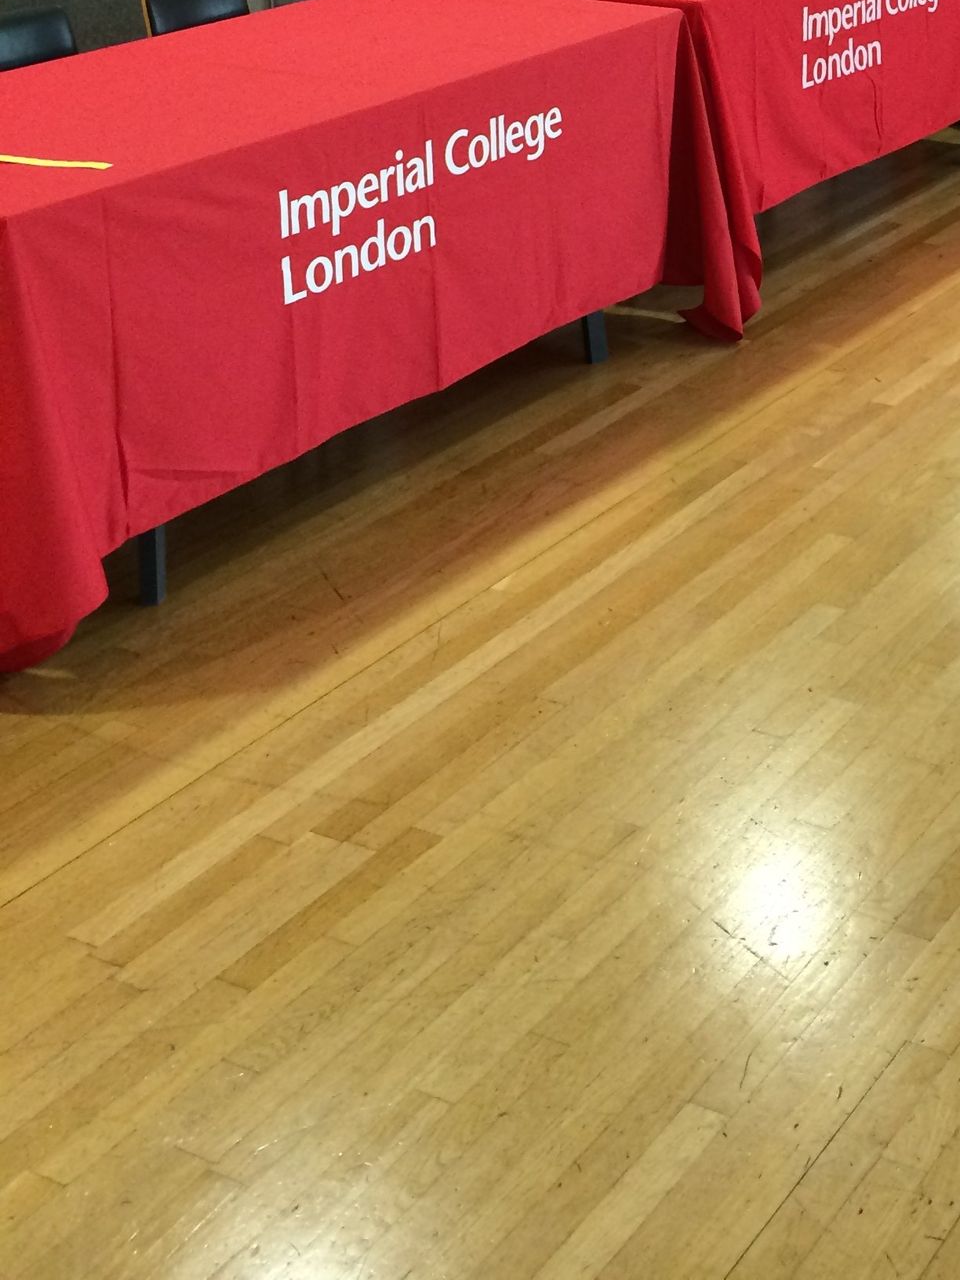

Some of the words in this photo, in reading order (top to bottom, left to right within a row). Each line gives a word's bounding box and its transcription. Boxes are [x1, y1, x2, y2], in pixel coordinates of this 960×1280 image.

[802, 37, 882, 89] London
[279, 139, 434, 239] Imperial
[445, 107, 563, 175] College
[281, 215, 436, 305] London
